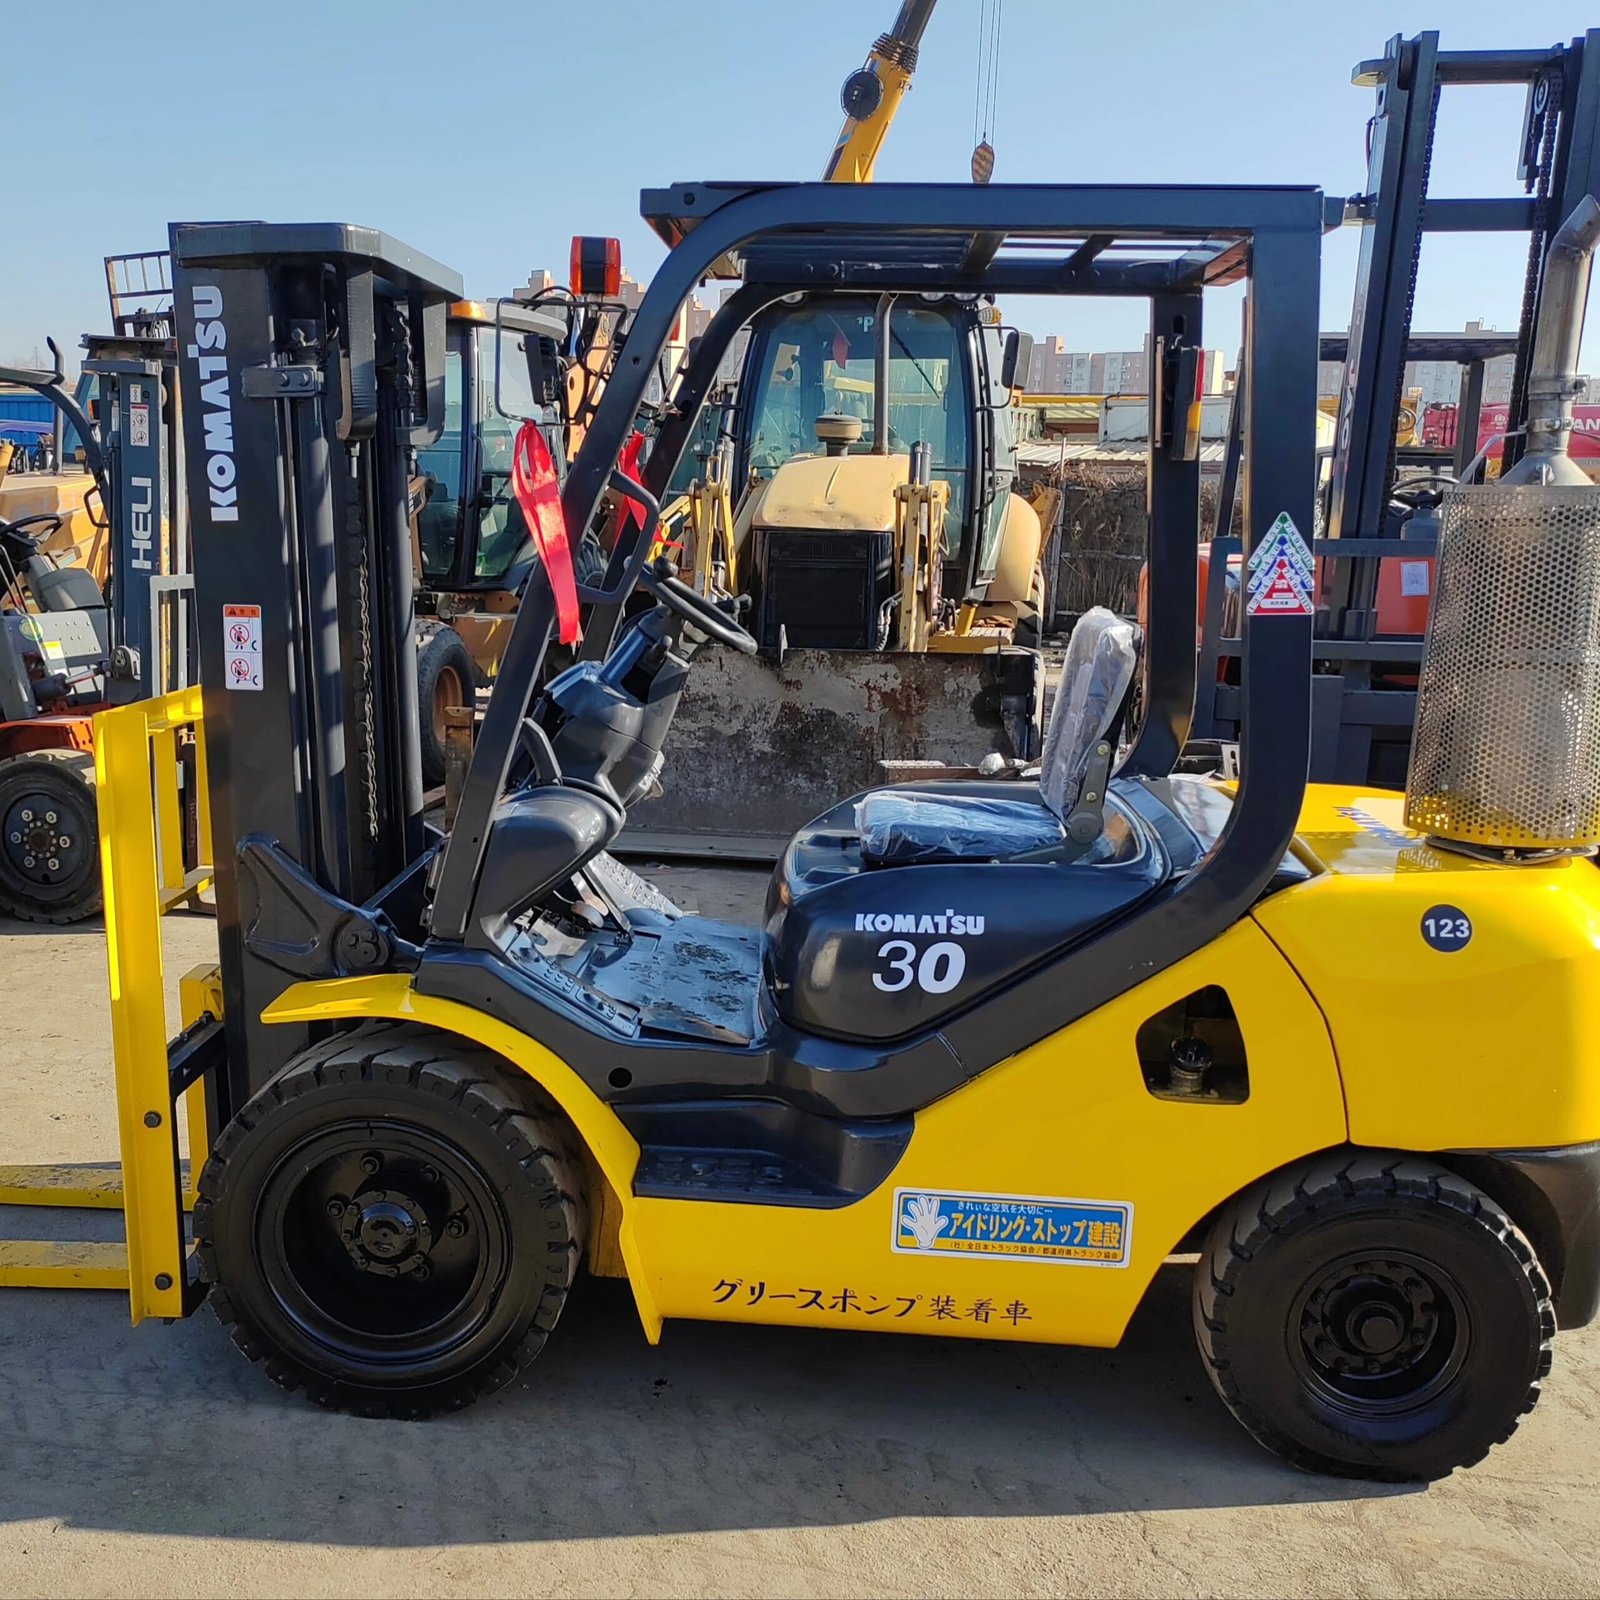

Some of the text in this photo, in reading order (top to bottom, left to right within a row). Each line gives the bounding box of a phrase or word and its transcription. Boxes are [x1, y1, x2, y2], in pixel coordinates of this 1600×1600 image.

[187, 285, 239, 522] KOMATSU
[131, 476, 152, 570] HELI
[855, 908, 985, 936] KOMATSU
[1424, 918, 1470, 938] 123
[872, 939, 966, 994] 30
[712, 1278, 1033, 1327] グリースポンプ装着車
